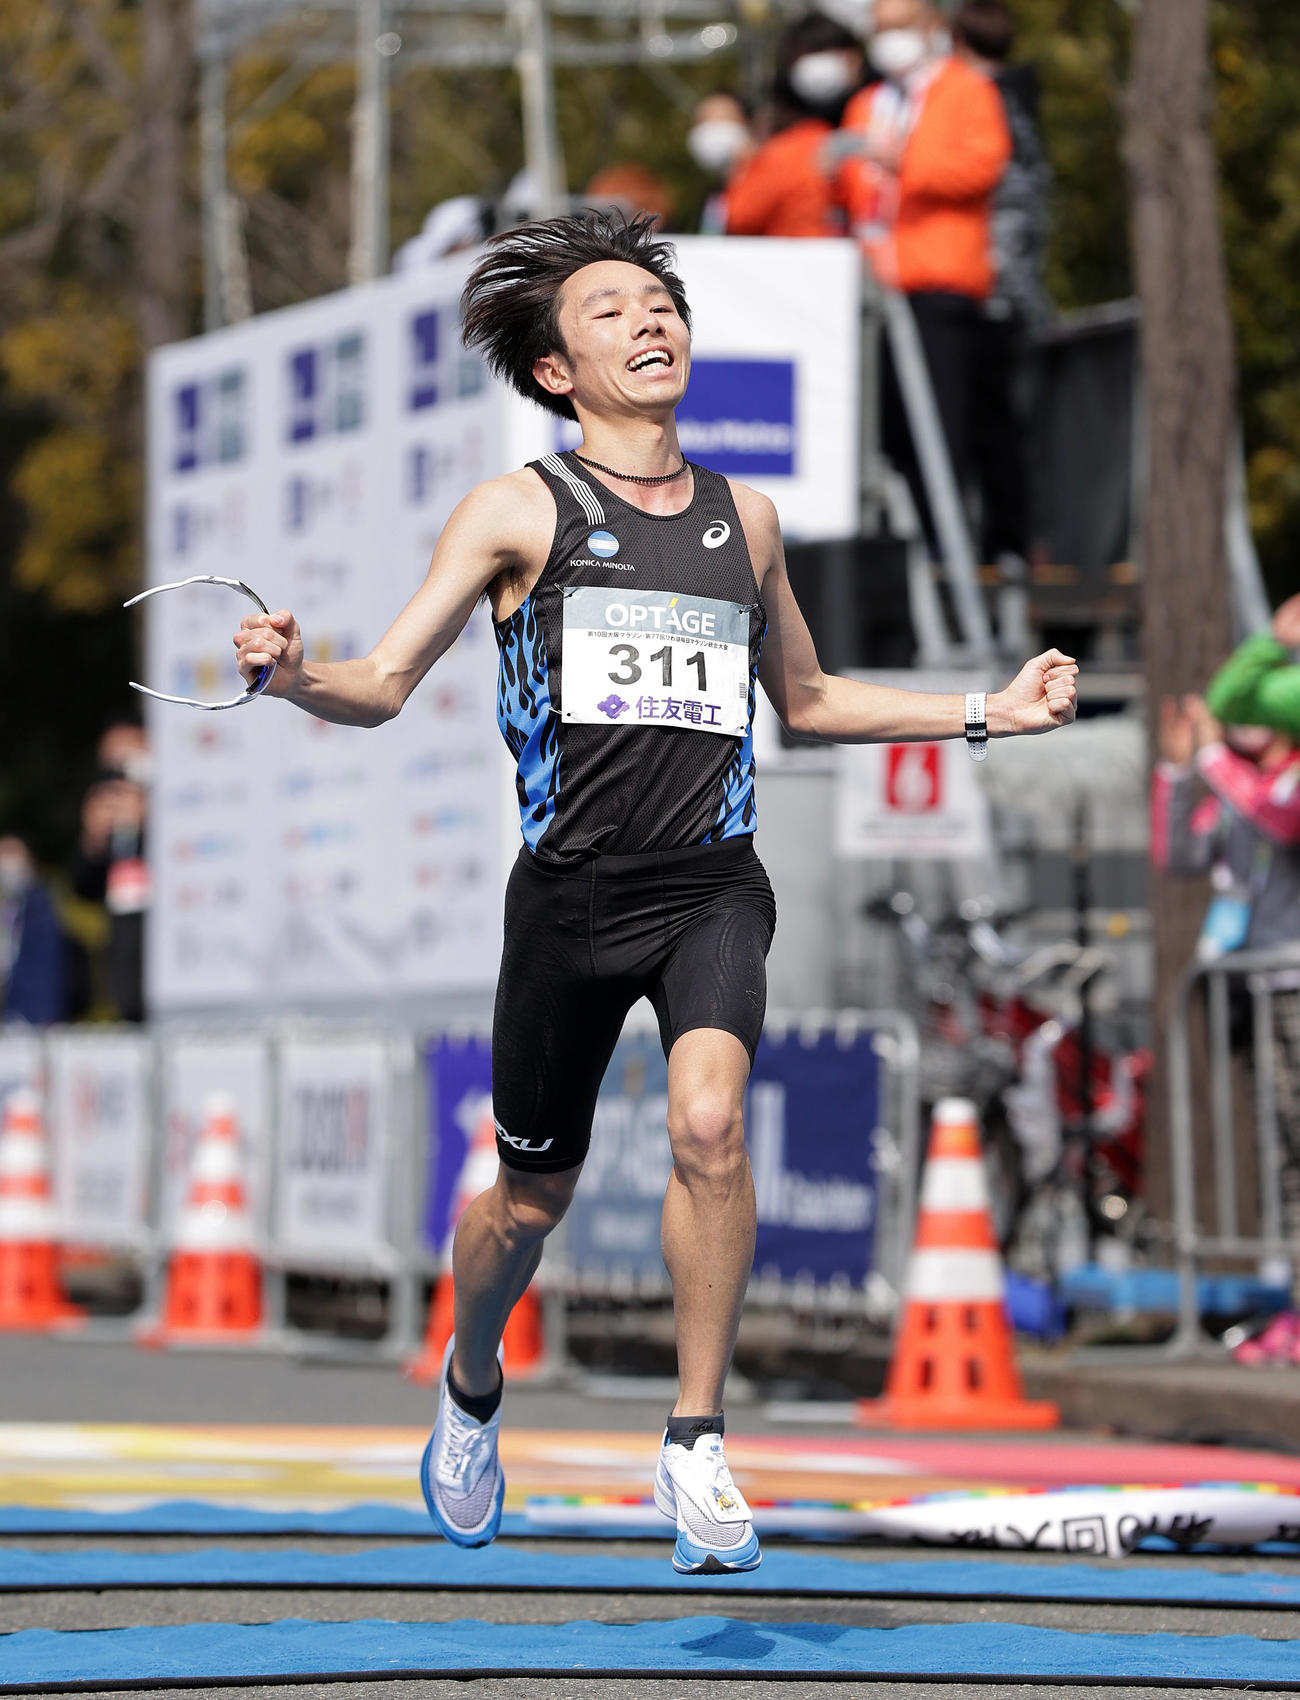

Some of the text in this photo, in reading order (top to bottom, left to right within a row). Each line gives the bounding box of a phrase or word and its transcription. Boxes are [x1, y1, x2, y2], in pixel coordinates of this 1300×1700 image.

[570, 559, 635, 571] KONICA MINOLTA
[604, 597, 716, 636] OPTAGE
[607, 643, 707, 691] 311
[635, 695, 722, 726] 住友電工
